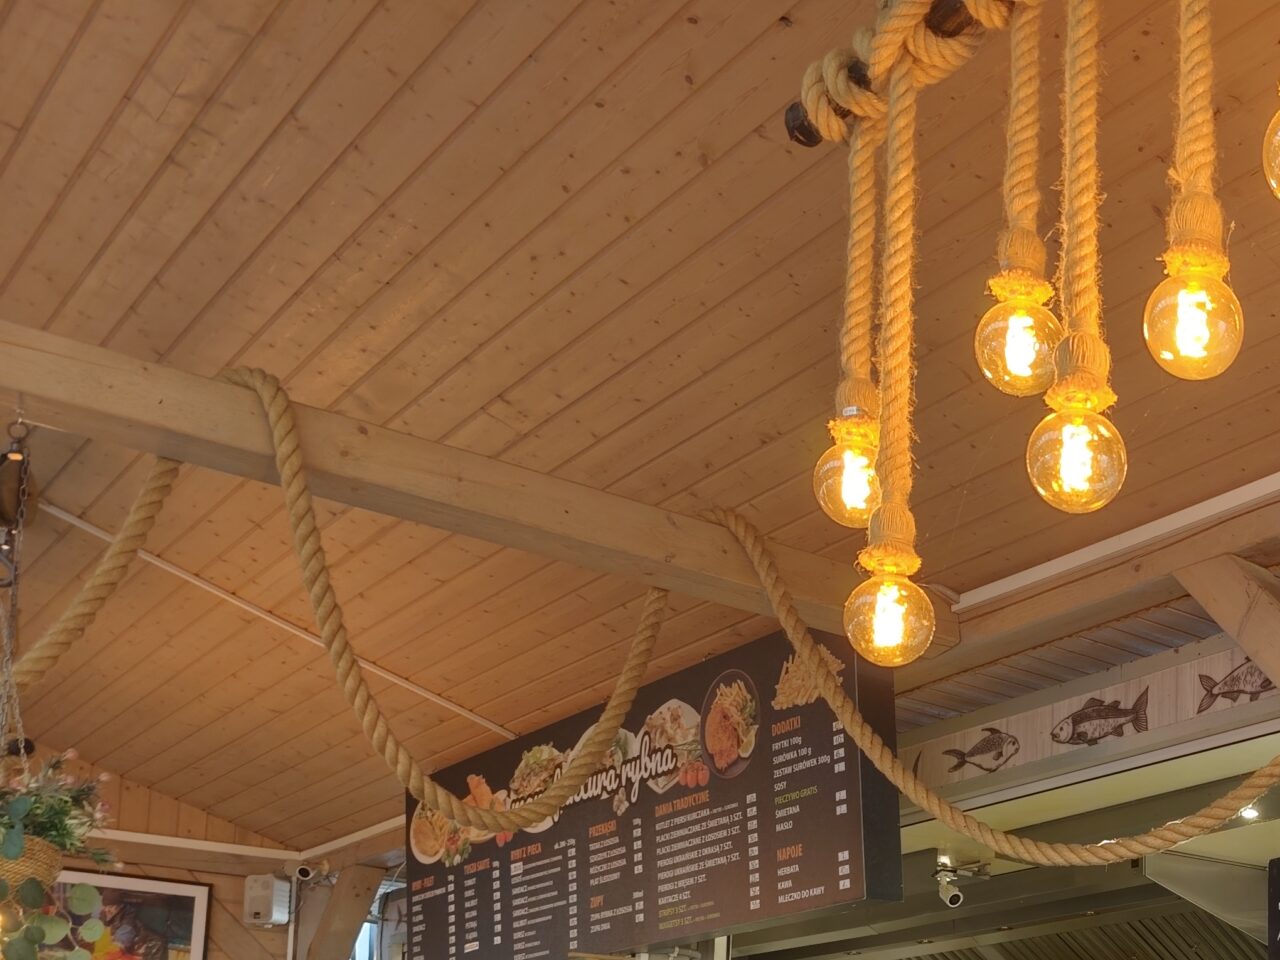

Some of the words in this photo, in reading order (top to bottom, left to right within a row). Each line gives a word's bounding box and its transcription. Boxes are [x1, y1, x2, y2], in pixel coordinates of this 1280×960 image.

[772, 716, 800, 736] DODATKI
[772, 739, 789, 751] FRYTKI
[773, 751, 797, 764] SURÓWKA
[621, 731, 677, 803] rybna
[774, 781, 787, 791] SOSY
[777, 843, 803, 861] NAPOJE
[777, 864, 799, 876] HERBATA
[778, 880, 793, 890] KAWA
